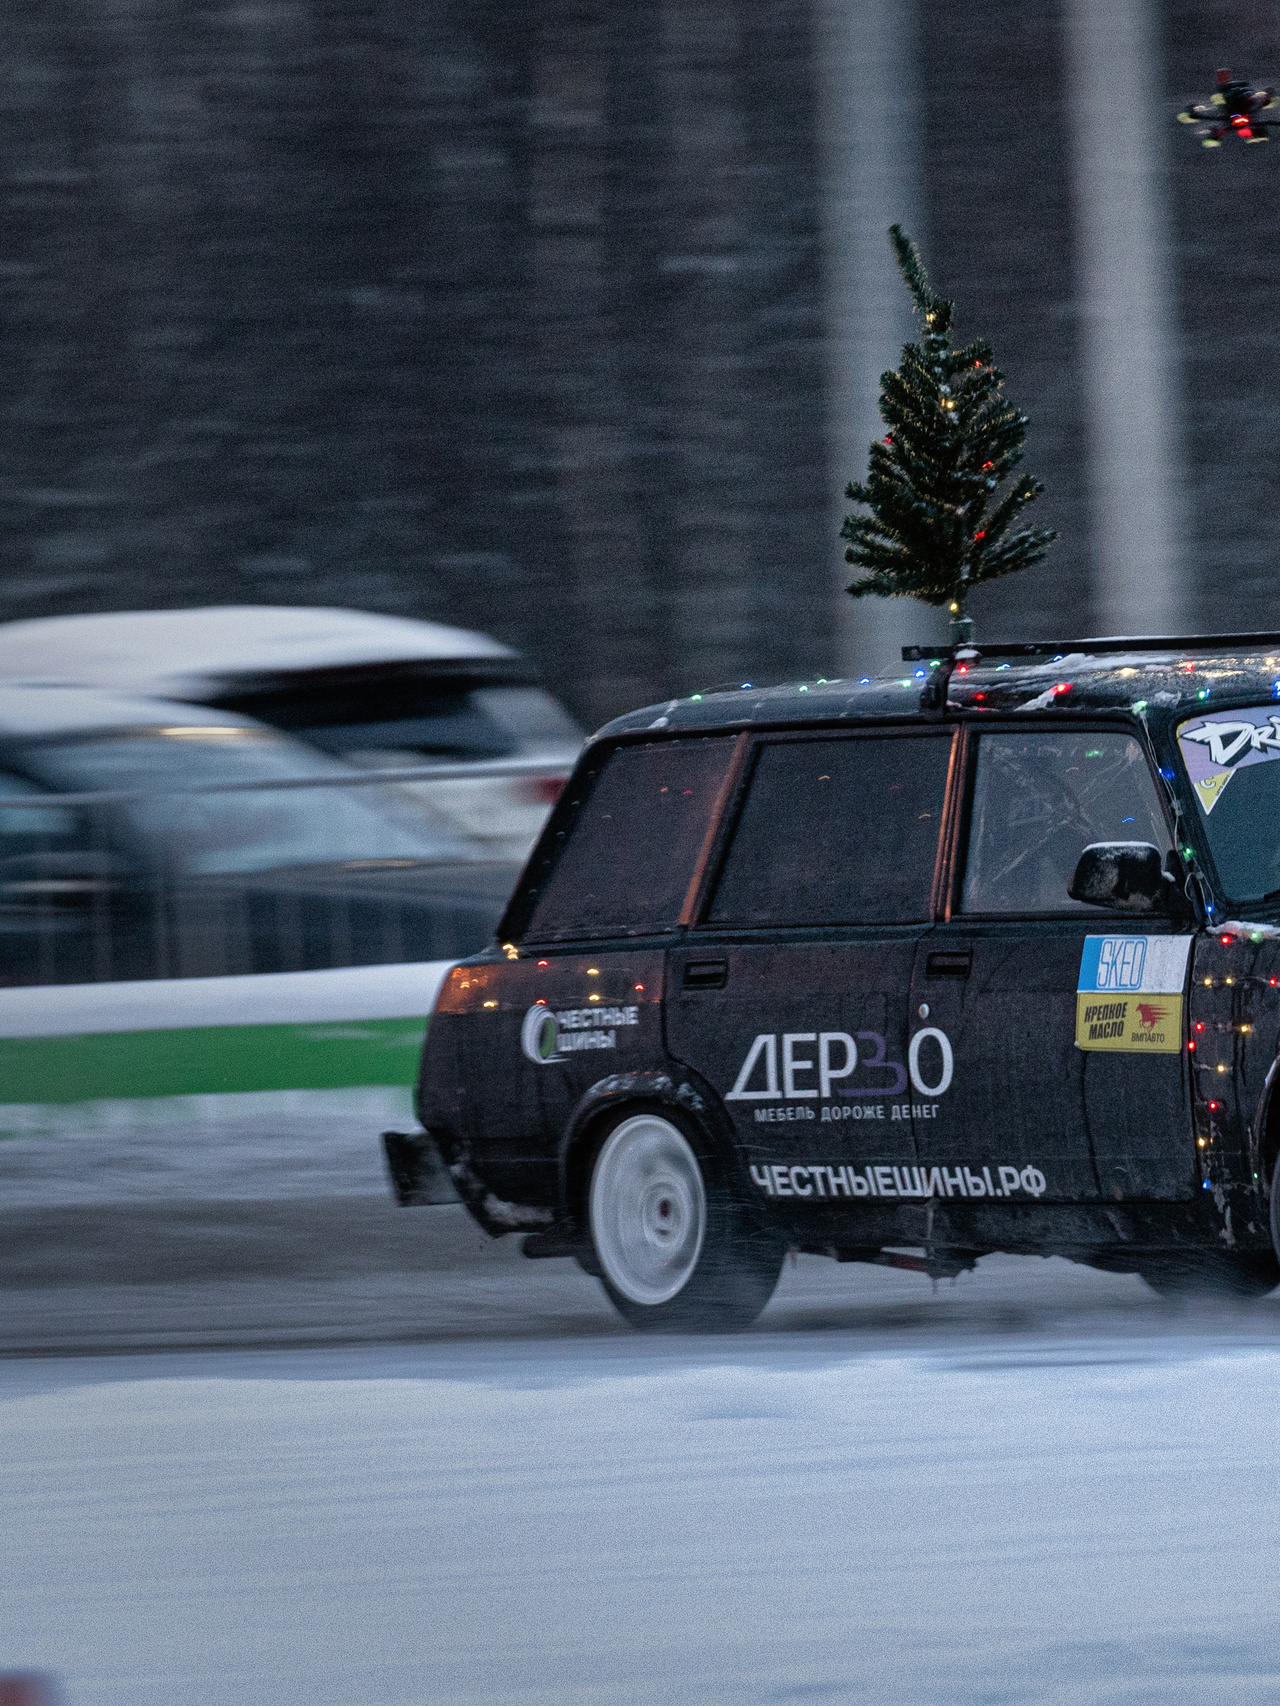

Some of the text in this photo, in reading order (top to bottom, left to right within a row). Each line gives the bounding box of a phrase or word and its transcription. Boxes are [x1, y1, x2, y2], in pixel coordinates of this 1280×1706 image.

[1097, 940, 1146, 988] SKEO
[556, 1006, 640, 1029] ЧЕСТНЫЕ
[1084, 1002, 1128, 1023] КРЕПКОЕ
[558, 1029, 617, 1052] ШИНЫ
[1088, 1021, 1125, 1040] МАСЛО
[724, 1027, 954, 1101] ДЕРЗО
[754, 1104, 940, 1123] МЕБЕЛЬ ДОРОЖЕ ДЕНЕГ
[750, 1165, 1047, 1198] ЧЕСТНЫЕШИНЫ.РФ
